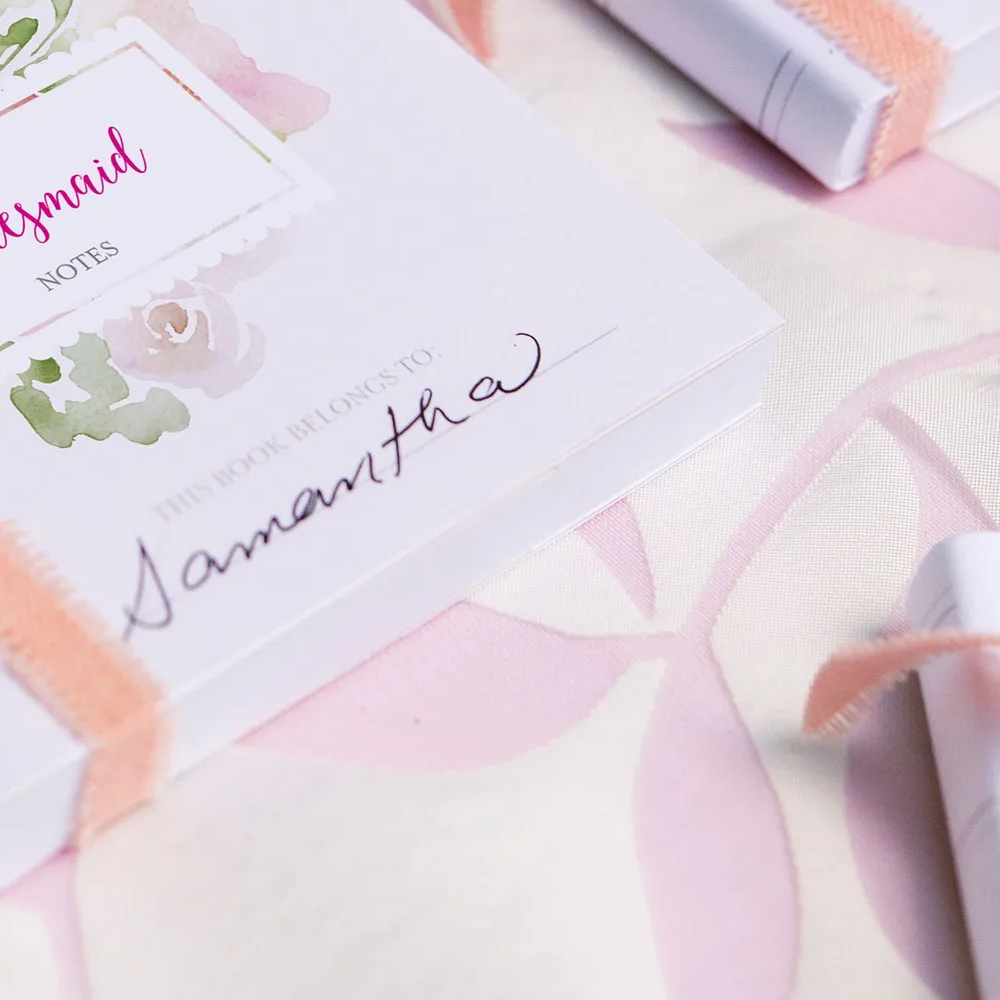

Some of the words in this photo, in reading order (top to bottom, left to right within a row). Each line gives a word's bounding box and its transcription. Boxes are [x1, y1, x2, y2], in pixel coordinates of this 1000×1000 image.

[35, 241, 119, 292] NOTES
[122, 332, 541, 641] Samantha
[150, 480, 215, 524] THIS
[210, 434, 291, 489] BOOK
[284, 367, 400, 443] BELONGS
[393, 344, 445, 375] TO:
